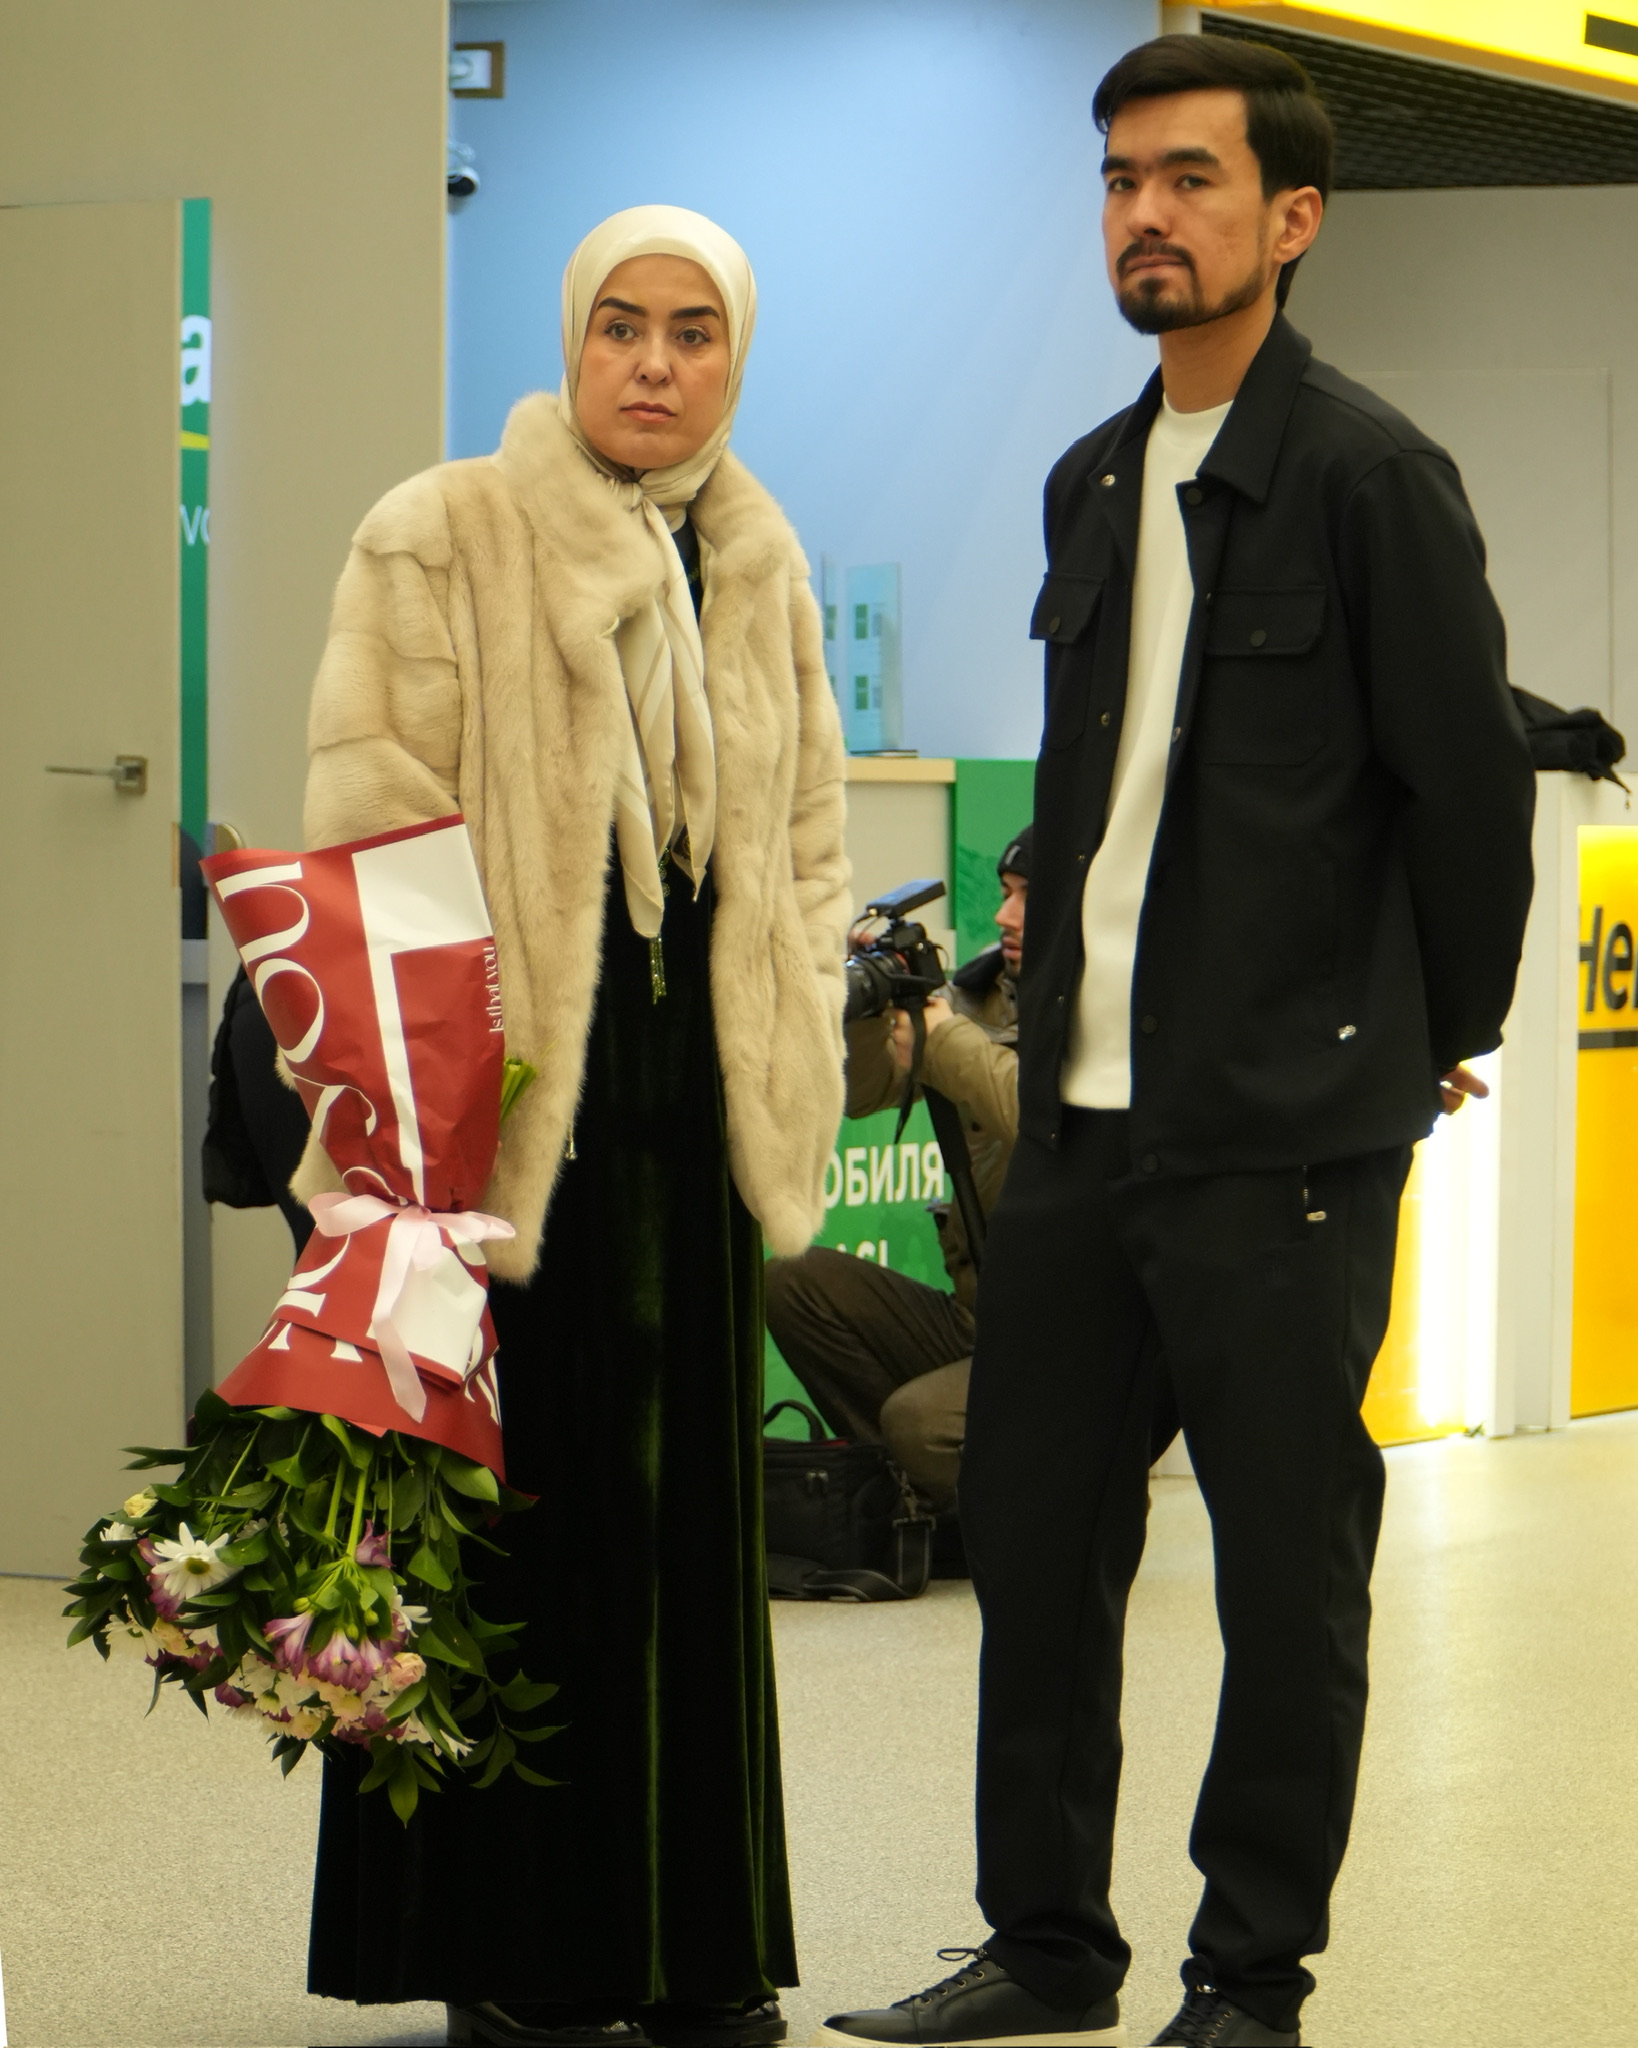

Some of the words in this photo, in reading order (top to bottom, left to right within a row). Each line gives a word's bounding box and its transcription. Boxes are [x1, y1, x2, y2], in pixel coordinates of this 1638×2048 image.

[1578, 905, 1638, 1014] He
[485, 983, 503, 1017] that
[489, 1018, 504, 1033] Is
